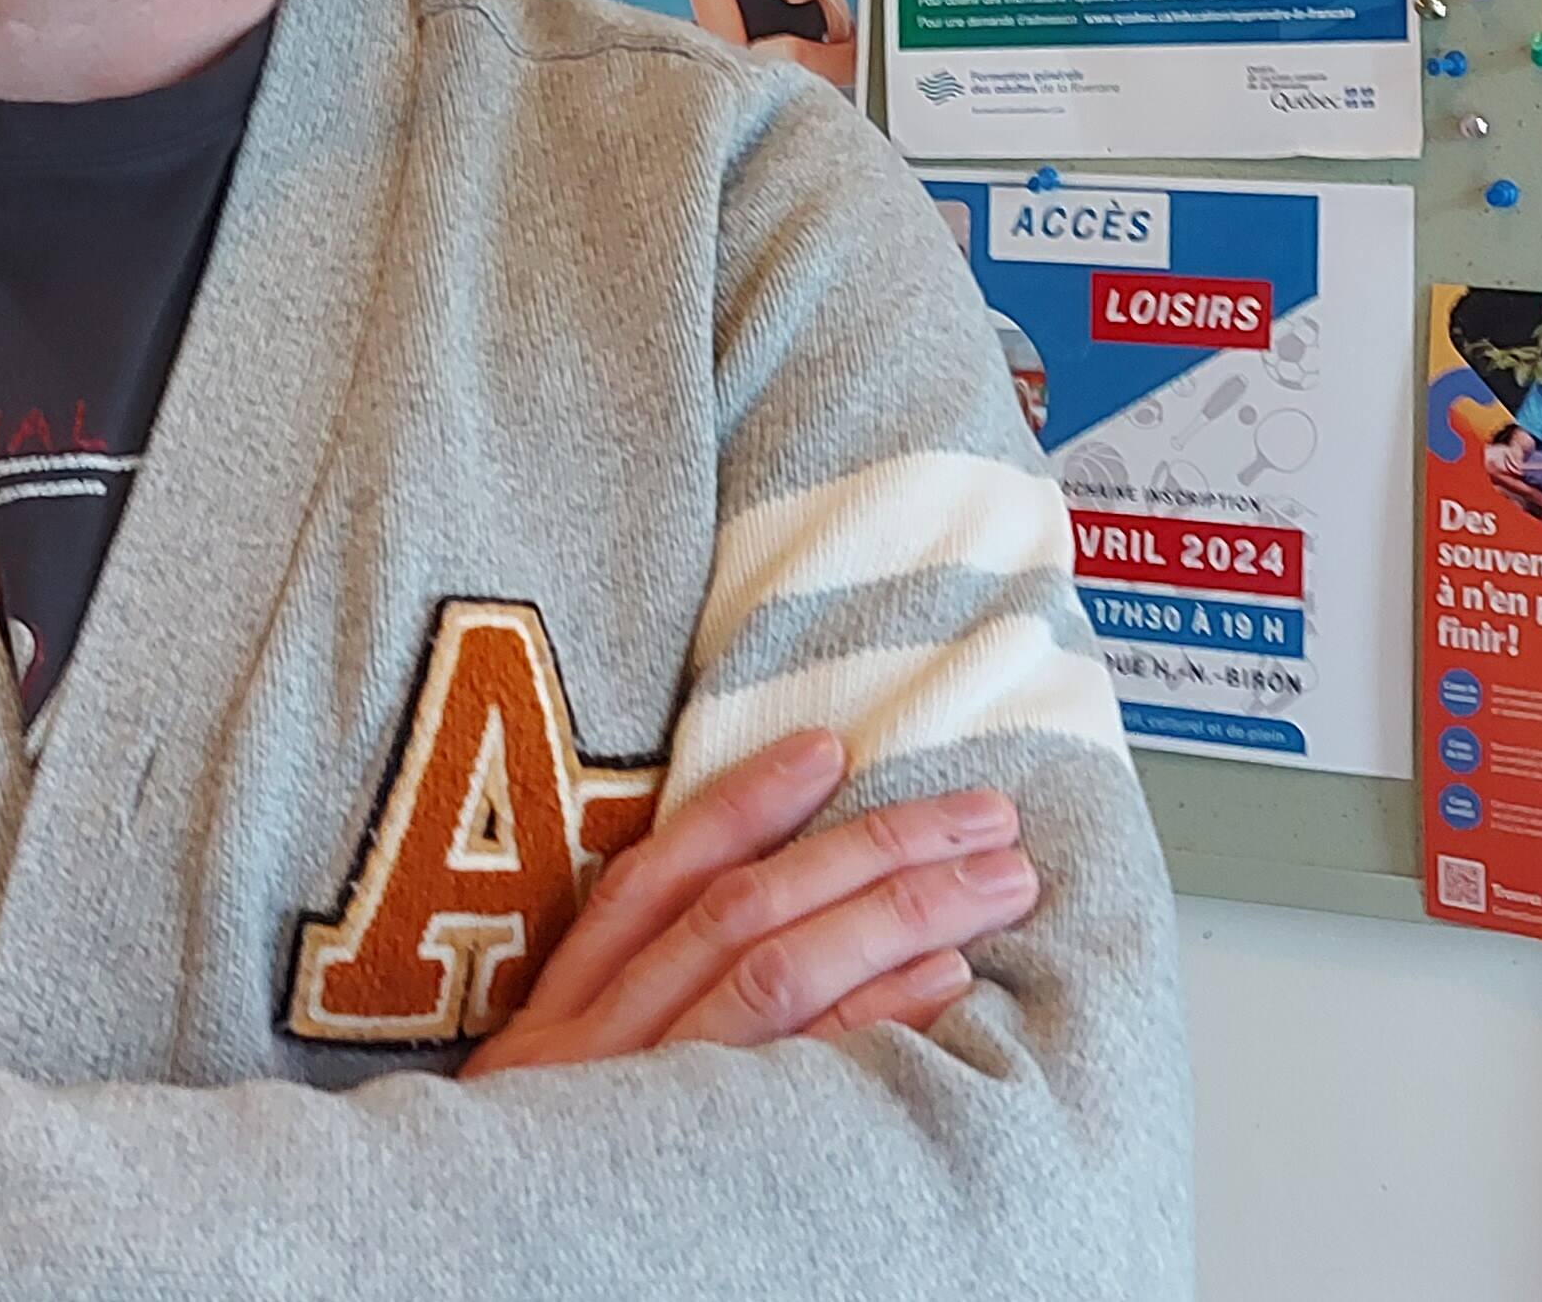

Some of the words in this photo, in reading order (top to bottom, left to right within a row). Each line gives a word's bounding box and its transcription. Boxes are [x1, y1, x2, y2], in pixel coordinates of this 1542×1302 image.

[1010, 199, 1152, 243] ACCÈS
[1105, 288, 1262, 332] LOISIRS
[1440, 498, 1497, 536] Des
[1181, 534, 1285, 578] 2024
[1436, 575, 1456, 608] à
[1462, 580, 1529, 617] n'en
[1094, 598, 1182, 633] 17H30
[1192, 602, 1212, 636] À
[1220, 611, 1254, 641] 19
[1263, 615, 1285, 645] H
[1437, 614, 1519, 657] finir!
